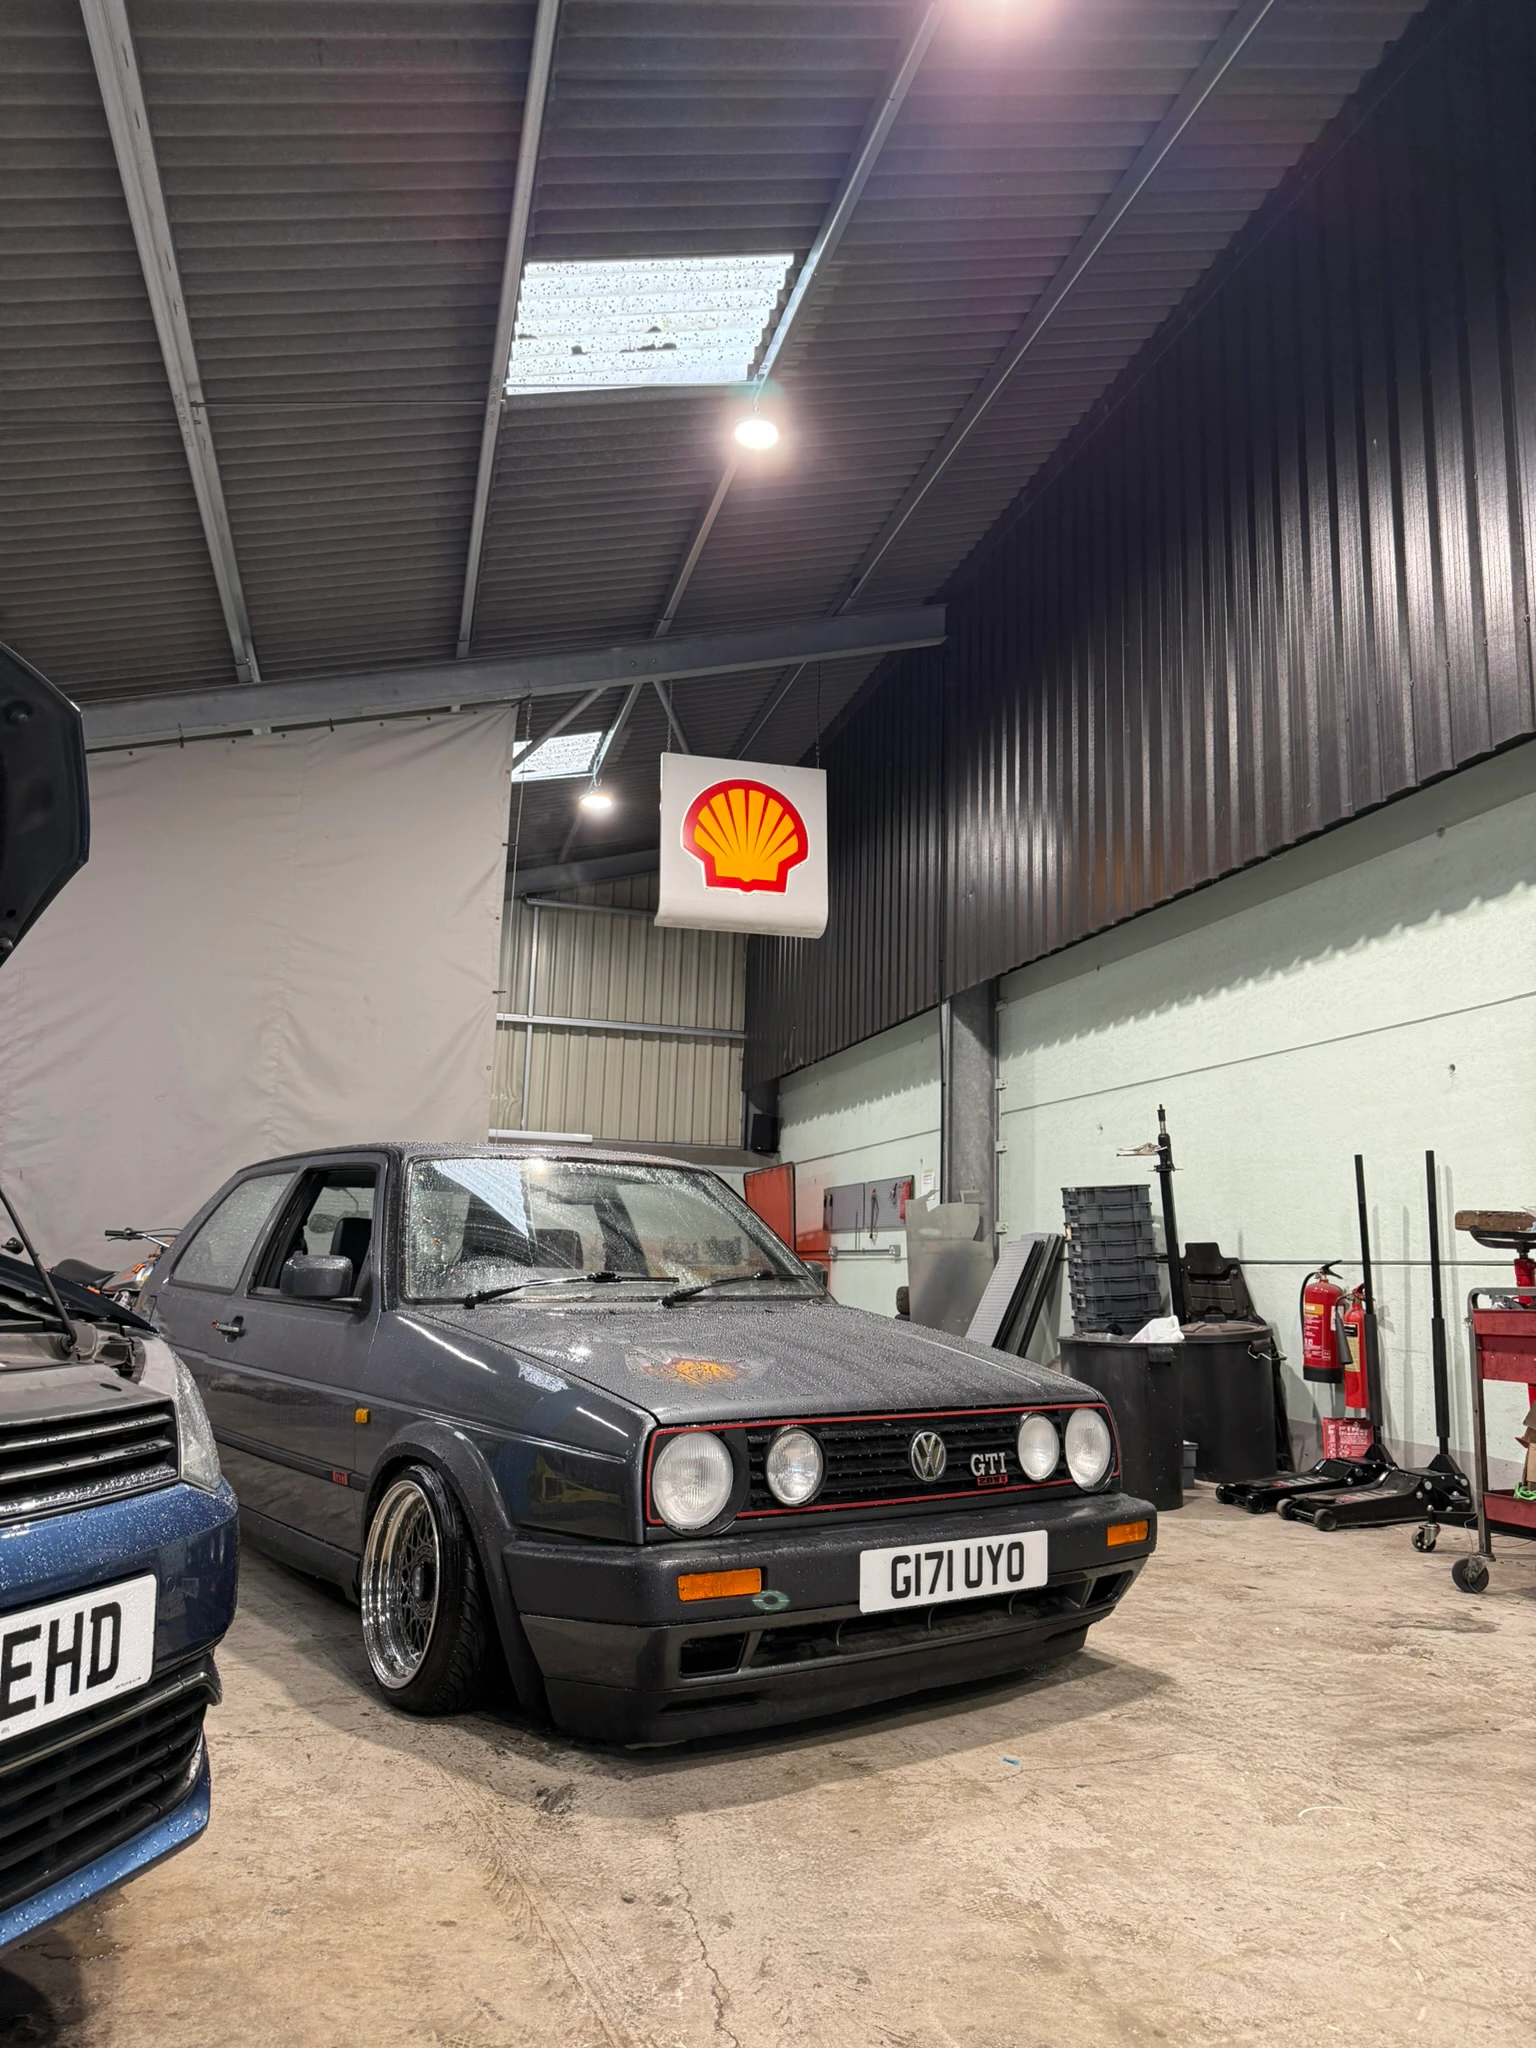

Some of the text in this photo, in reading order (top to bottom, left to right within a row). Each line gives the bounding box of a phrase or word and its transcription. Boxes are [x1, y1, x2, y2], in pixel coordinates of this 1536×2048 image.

[970, 1452, 1007, 1476] GTI
[891, 1541, 1025, 1599] G171 UYO
[0, 1602, 122, 1722] EHD
